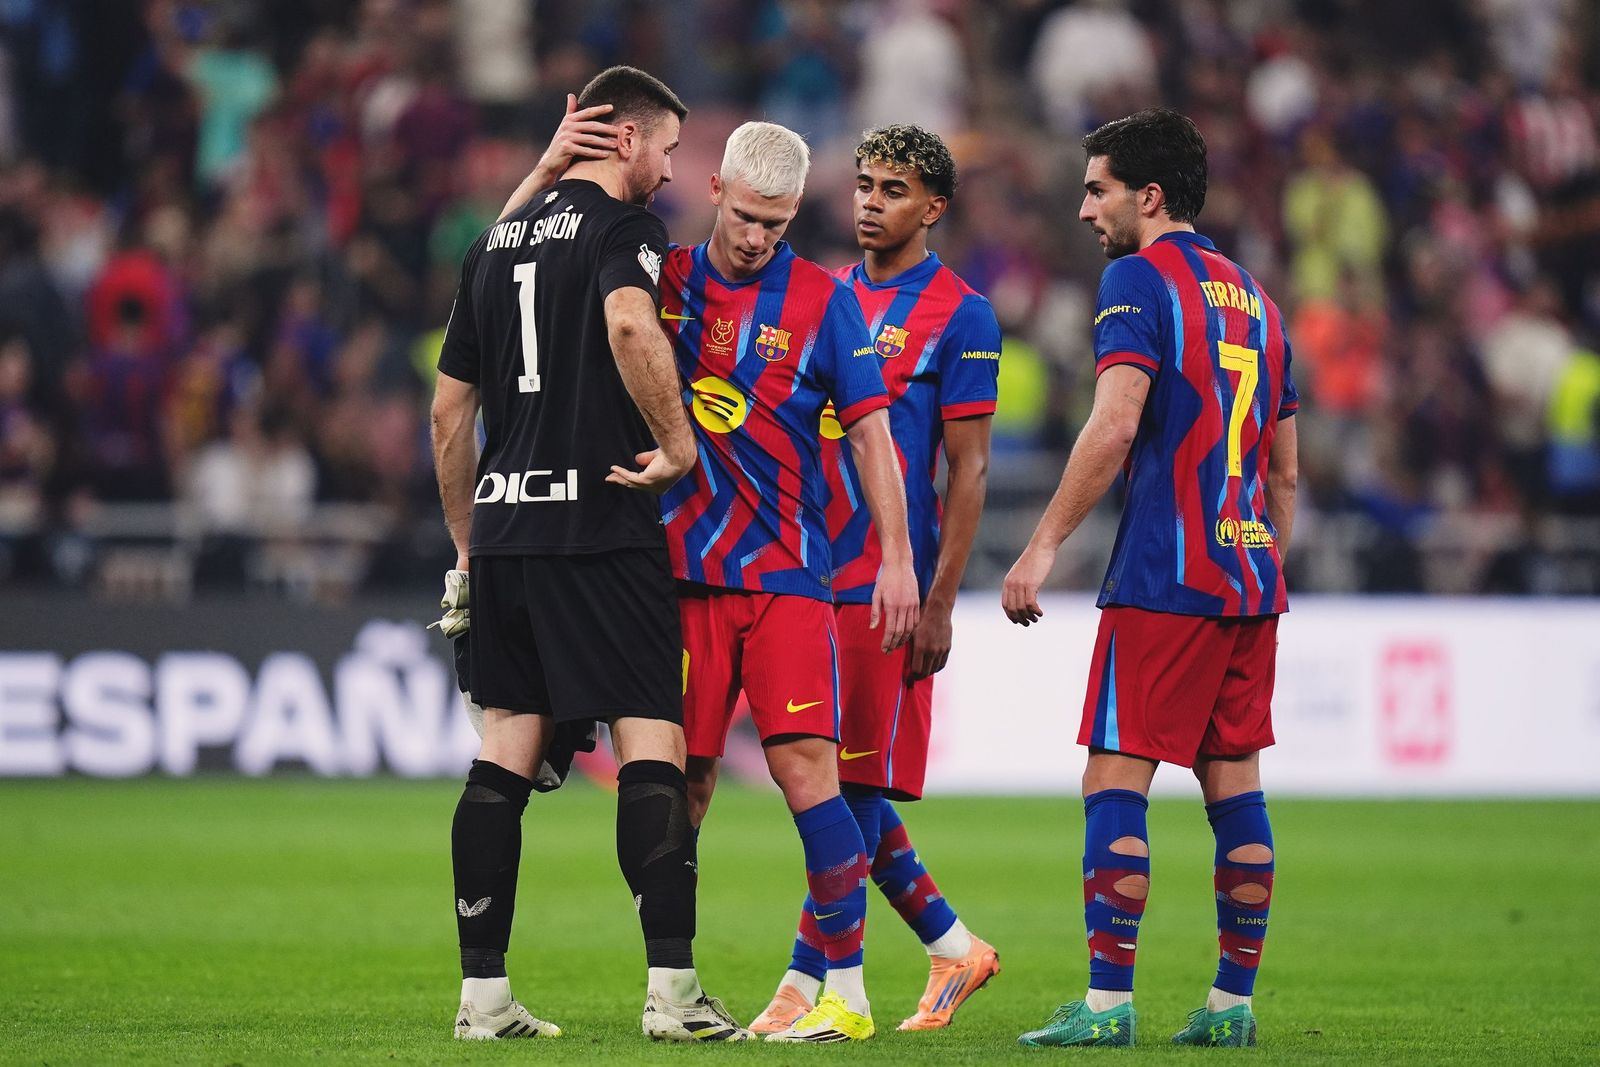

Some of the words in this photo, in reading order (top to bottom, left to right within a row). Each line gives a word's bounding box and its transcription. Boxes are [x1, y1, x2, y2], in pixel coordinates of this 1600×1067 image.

[486, 219, 528, 252] UNAI
[513, 261, 541, 393] 1
[1217, 340, 1259, 477] 7
[474, 468, 578, 504] DIGI
